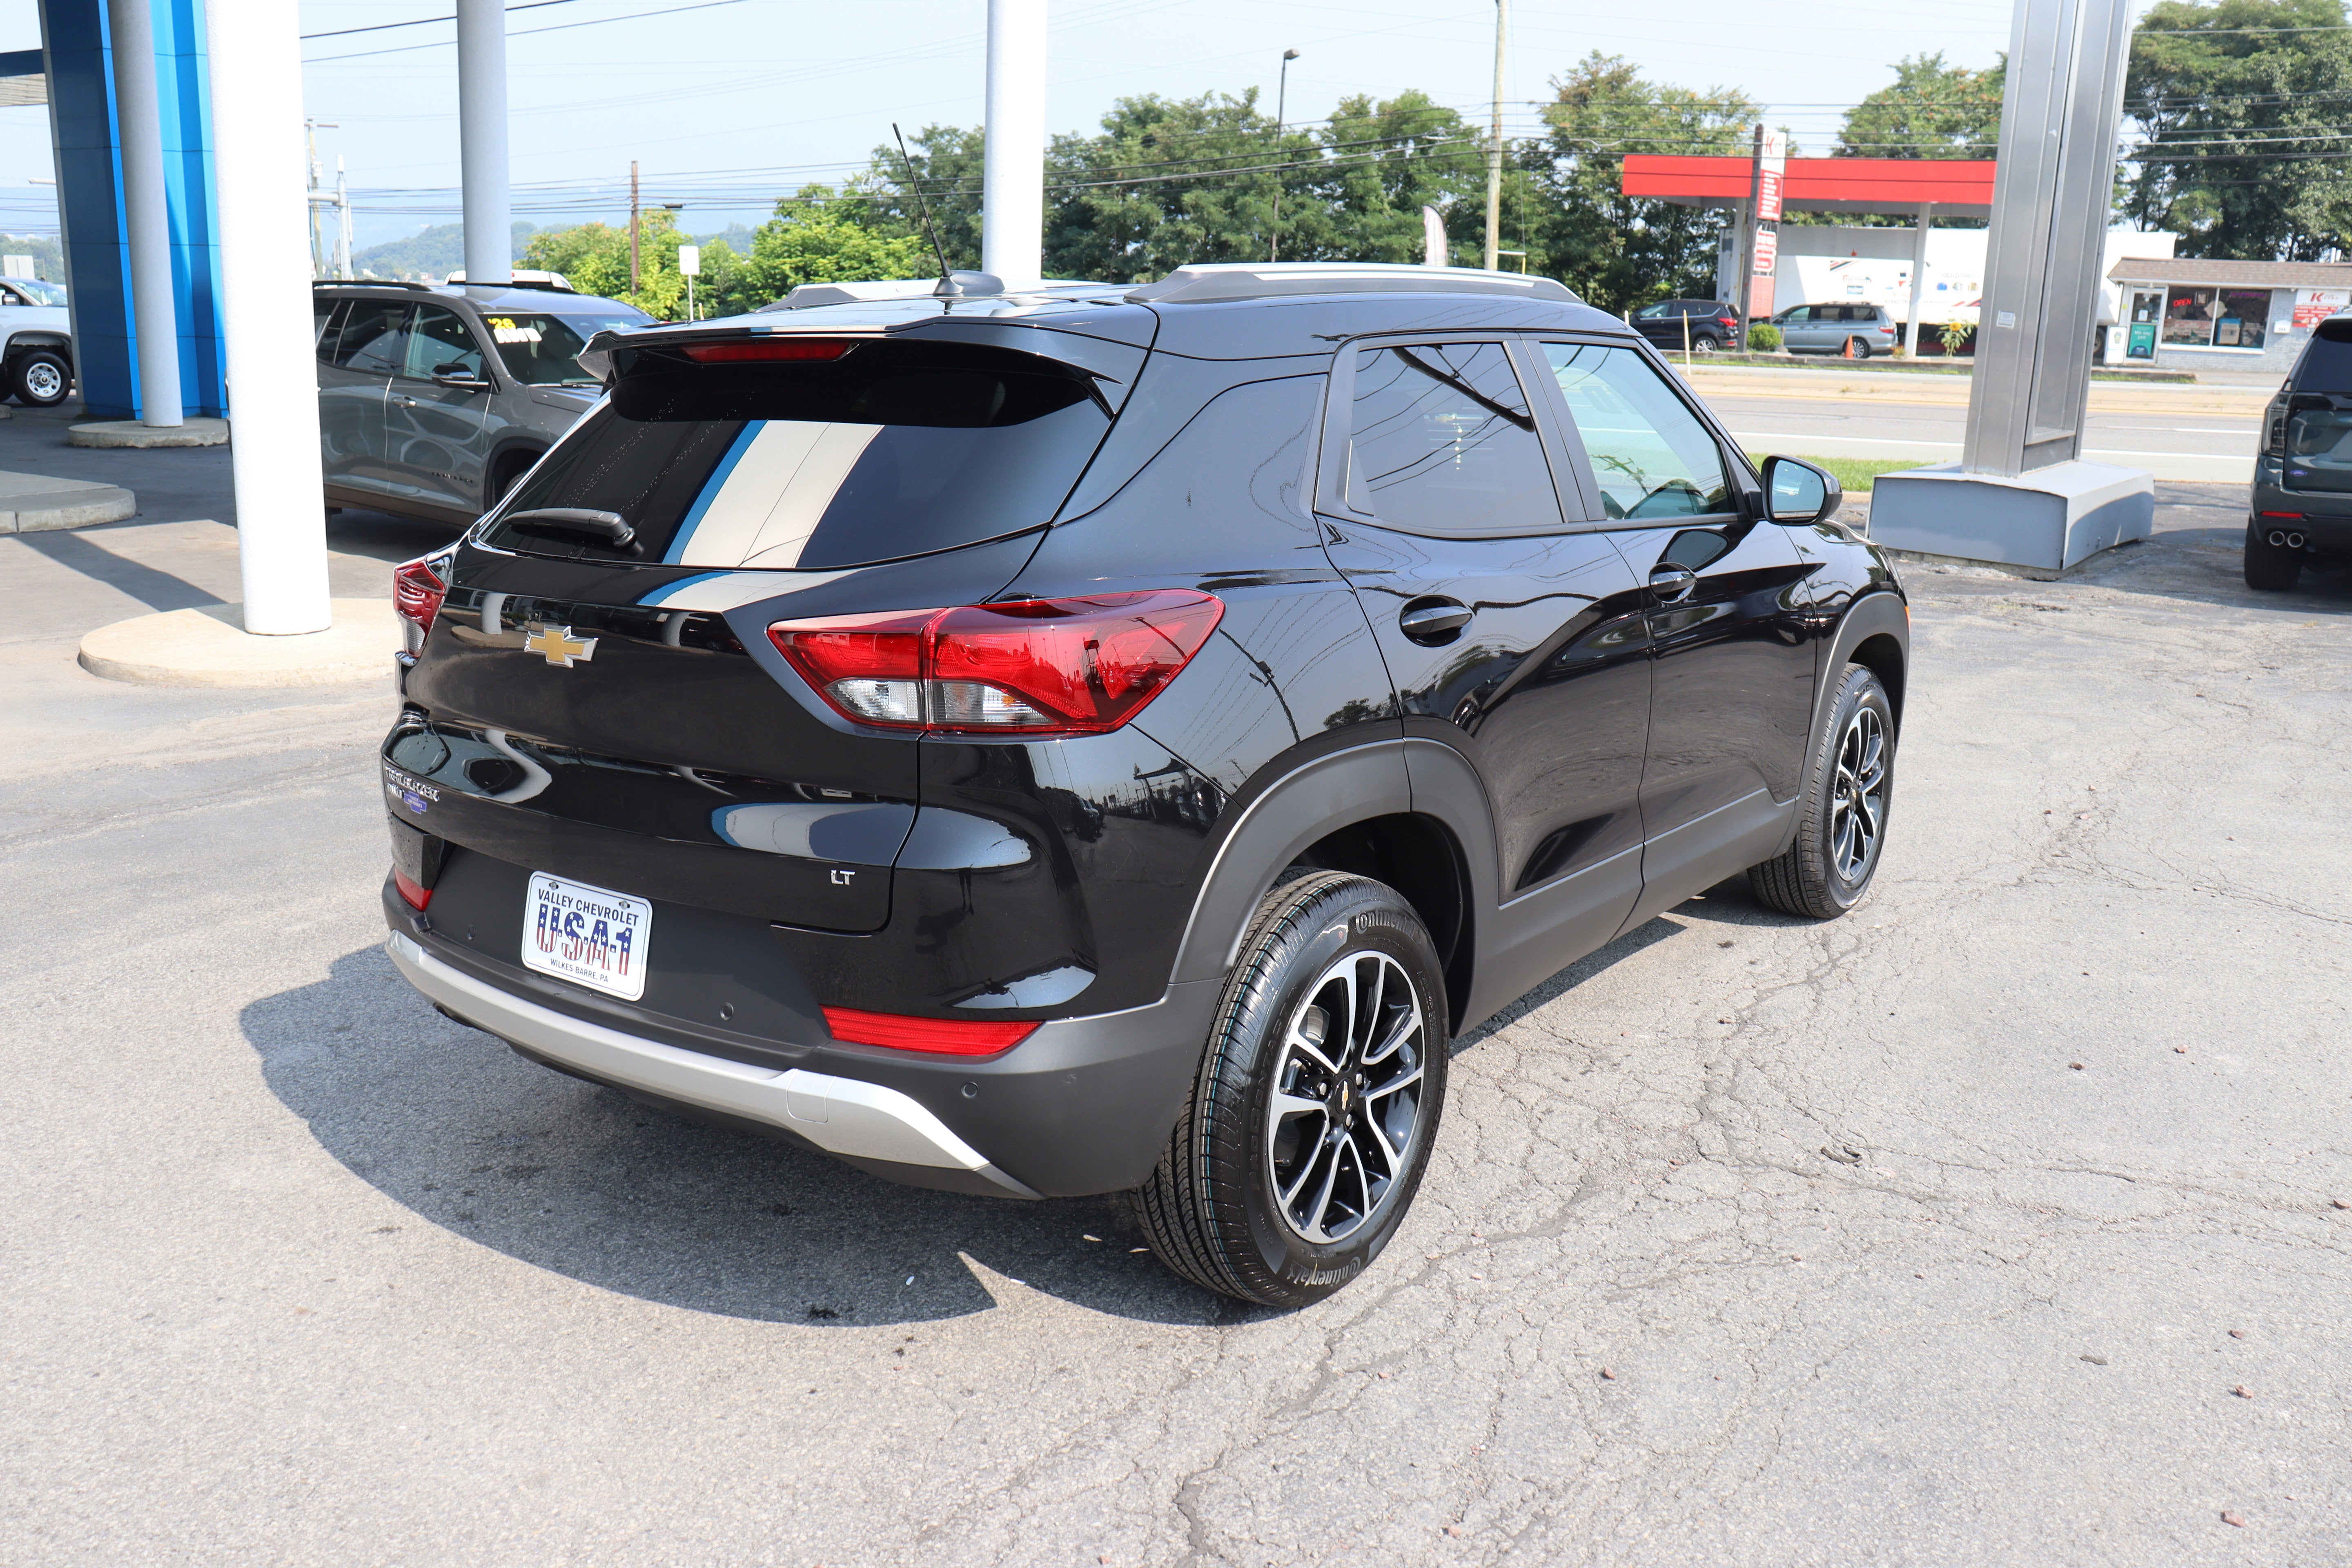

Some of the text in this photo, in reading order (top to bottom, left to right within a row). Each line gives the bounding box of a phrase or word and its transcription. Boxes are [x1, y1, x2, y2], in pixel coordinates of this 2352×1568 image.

[2173, 298, 2192, 307] OPEN
[385, 766, 440, 802] TRAILBLAZER
[831, 869, 855, 886] LT
[538, 889, 639, 926] VALLEY CHEVROLET
[1355, 909, 1415, 940] Continental
[550, 958, 608, 983] WILKES-BARRE, PA
[1293, 1256, 1361, 1287] Continental
